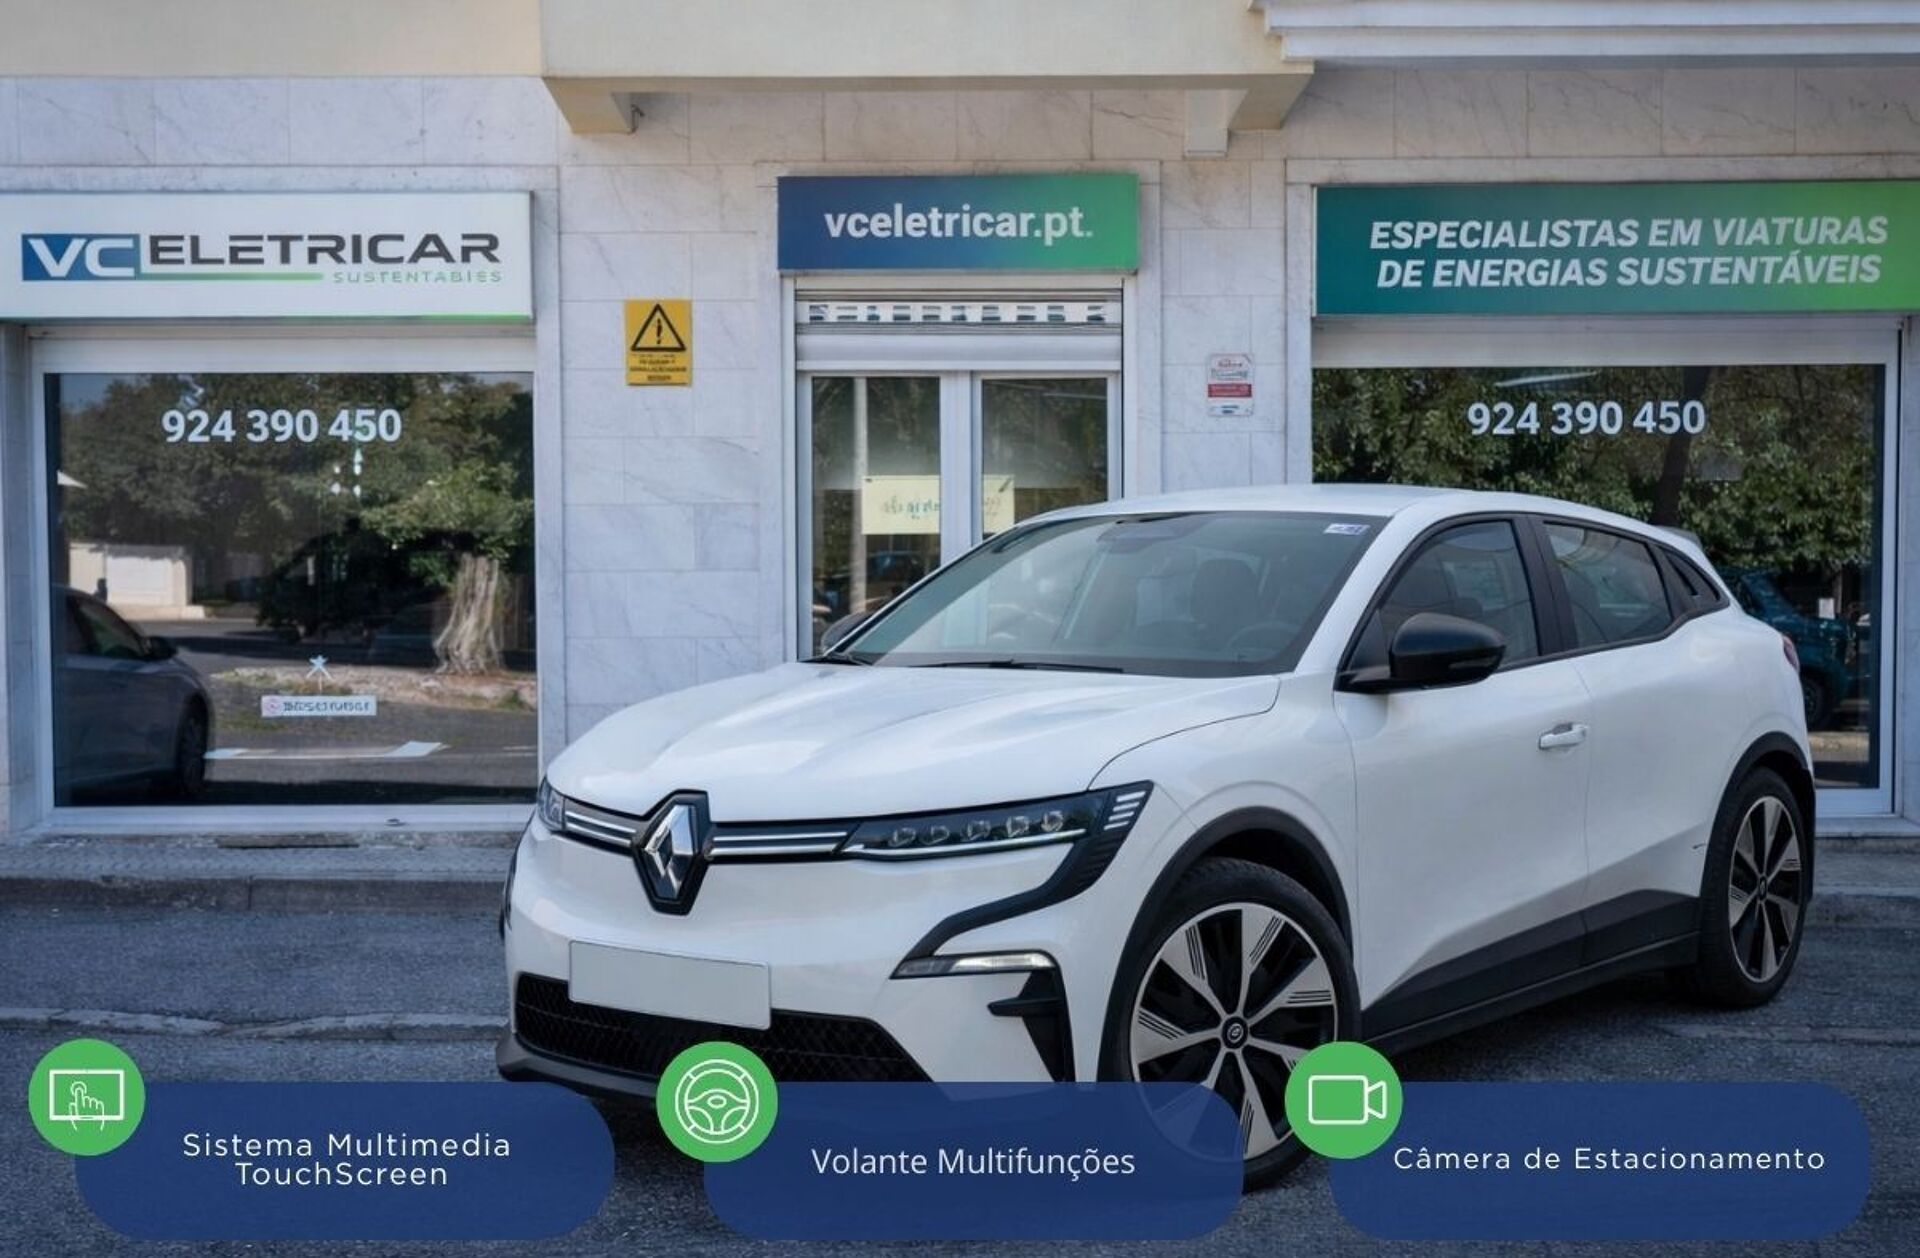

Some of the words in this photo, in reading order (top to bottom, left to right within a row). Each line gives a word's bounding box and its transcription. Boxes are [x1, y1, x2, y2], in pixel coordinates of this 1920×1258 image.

[1370, 219, 1639, 250] ESPECIALISTAS
[1648, 218, 1702, 247] EM
[1714, 215, 1889, 246] VIATURAS
[1377, 259, 1424, 288] DE
[1433, 257, 1607, 288] ENERGIAS
[1616, 250, 1882, 286] SUSTENTÁVEIS
[162, 409, 236, 442] 924
[246, 410, 318, 442] 390
[328, 409, 402, 442] 450
[1468, 402, 1540, 435] 924
[1551, 401, 1623, 434] 390
[1633, 400, 1706, 434] 450
